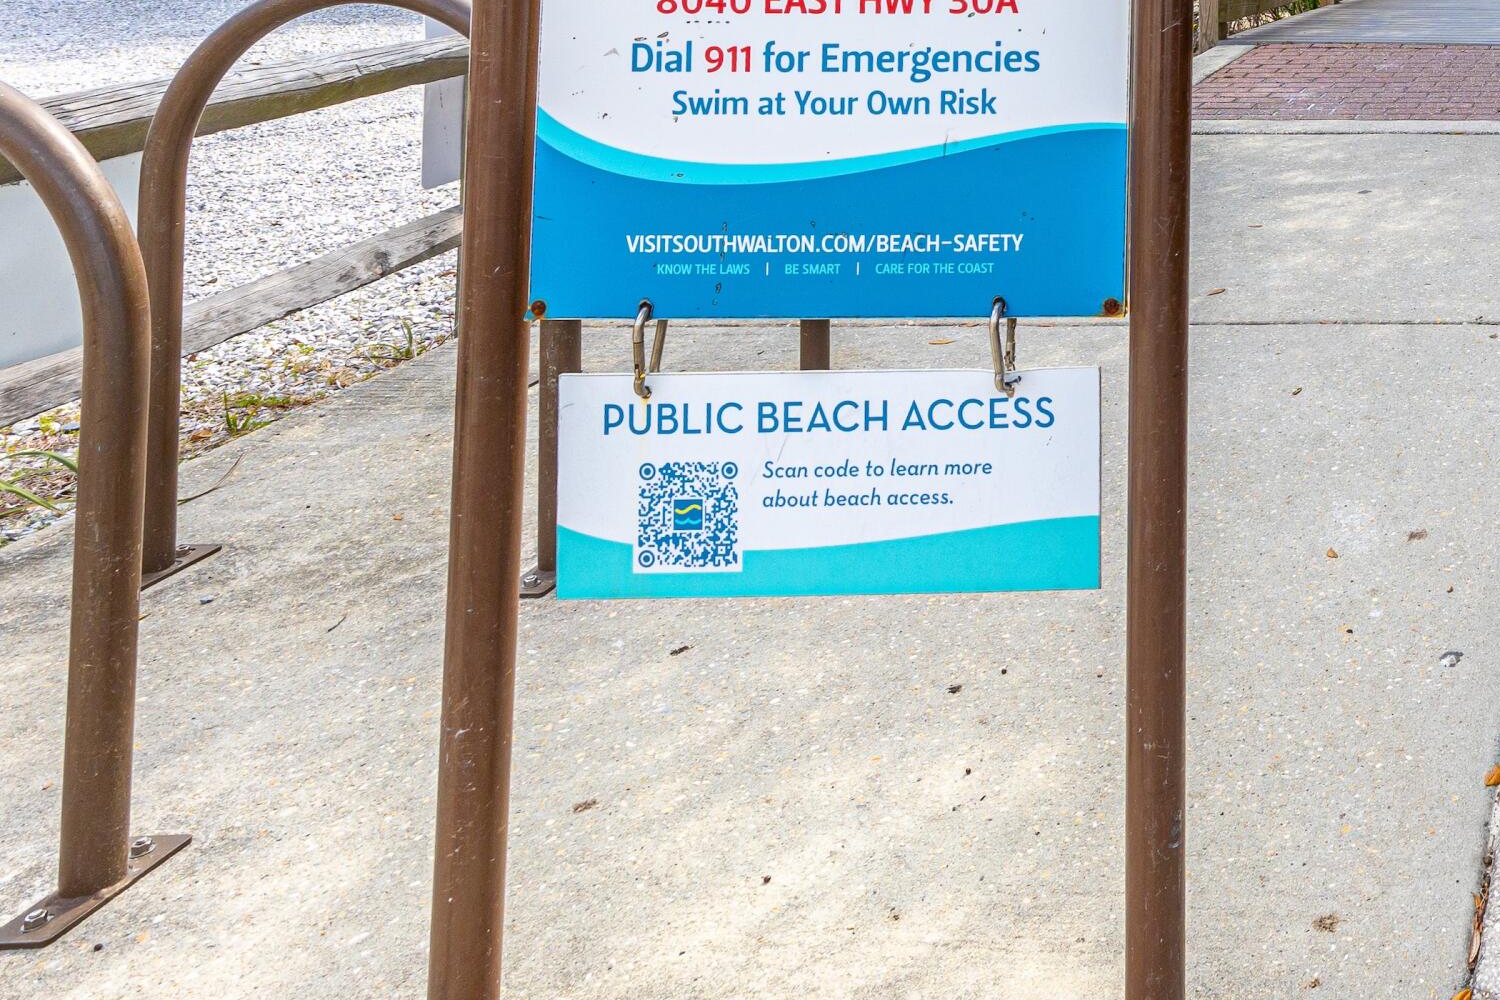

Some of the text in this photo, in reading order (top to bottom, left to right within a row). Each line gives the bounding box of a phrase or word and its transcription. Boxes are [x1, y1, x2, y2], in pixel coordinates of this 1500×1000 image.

[631, 41, 1041, 82] Dial 911 for Emergencies
[671, 88, 997, 115] Swim at Your Own Risk
[626, 233, 1024, 254] VISITSOUTHWALTON.COM/BEACH-SAFETY
[657, 264, 751, 275] KNOW THE LAWS
[784, 264, 840, 275] BE SMART
[875, 263, 994, 275] CARE FOR THE COAST
[603, 396, 1056, 436] PUBLIC BEACH ACCESS
[762, 458, 993, 479] Scan code to learn more
[762, 488, 954, 508] about beach access.
